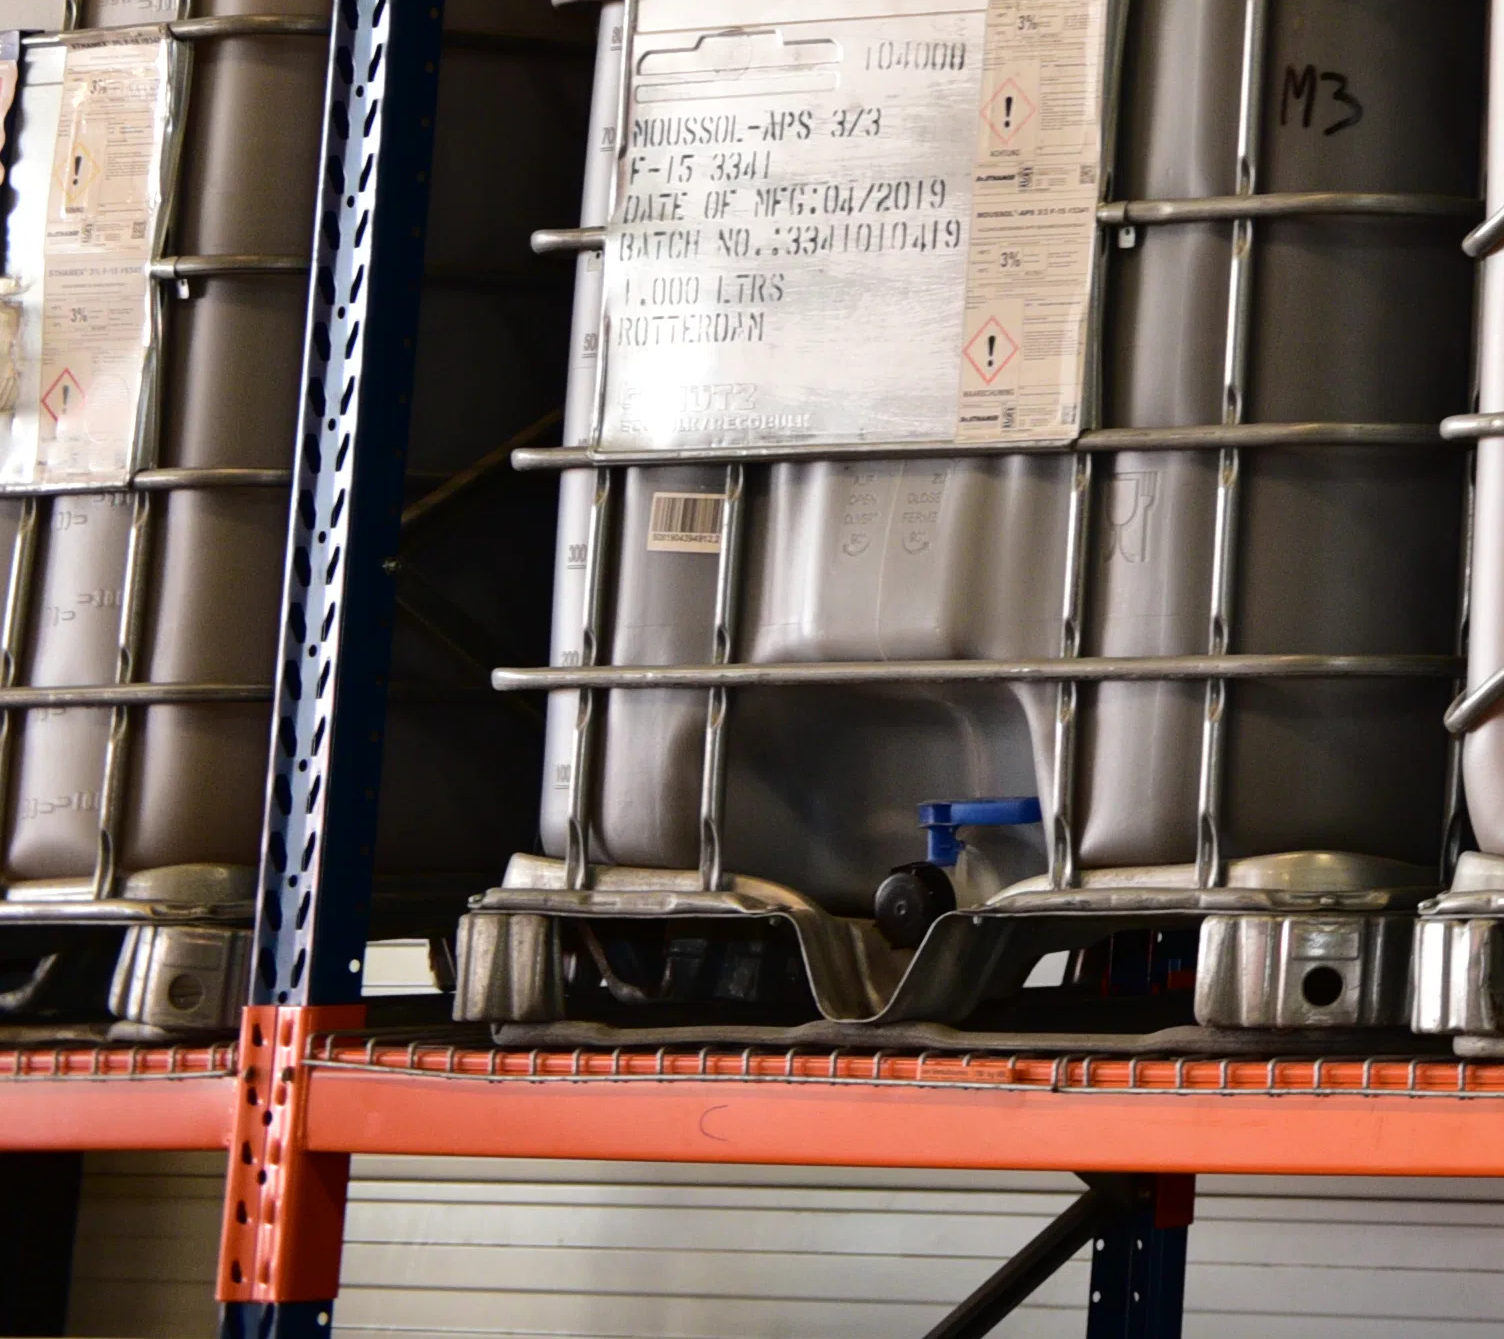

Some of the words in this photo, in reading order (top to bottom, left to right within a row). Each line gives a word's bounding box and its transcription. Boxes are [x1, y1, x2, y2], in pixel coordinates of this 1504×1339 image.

[633, 110, 812, 147] MOUSSOL-APS
[831, 106, 882, 137] 3/3
[630, 154, 694, 185] F-15
[711, 150, 771, 182] 3341
[624, 192, 688, 224] DATE
[704, 189, 737, 220] OF
[619, 228, 700, 262] BATCH
[718, 272, 784, 305] LTRS
[618, 311, 765, 347] ROTTERDAM
